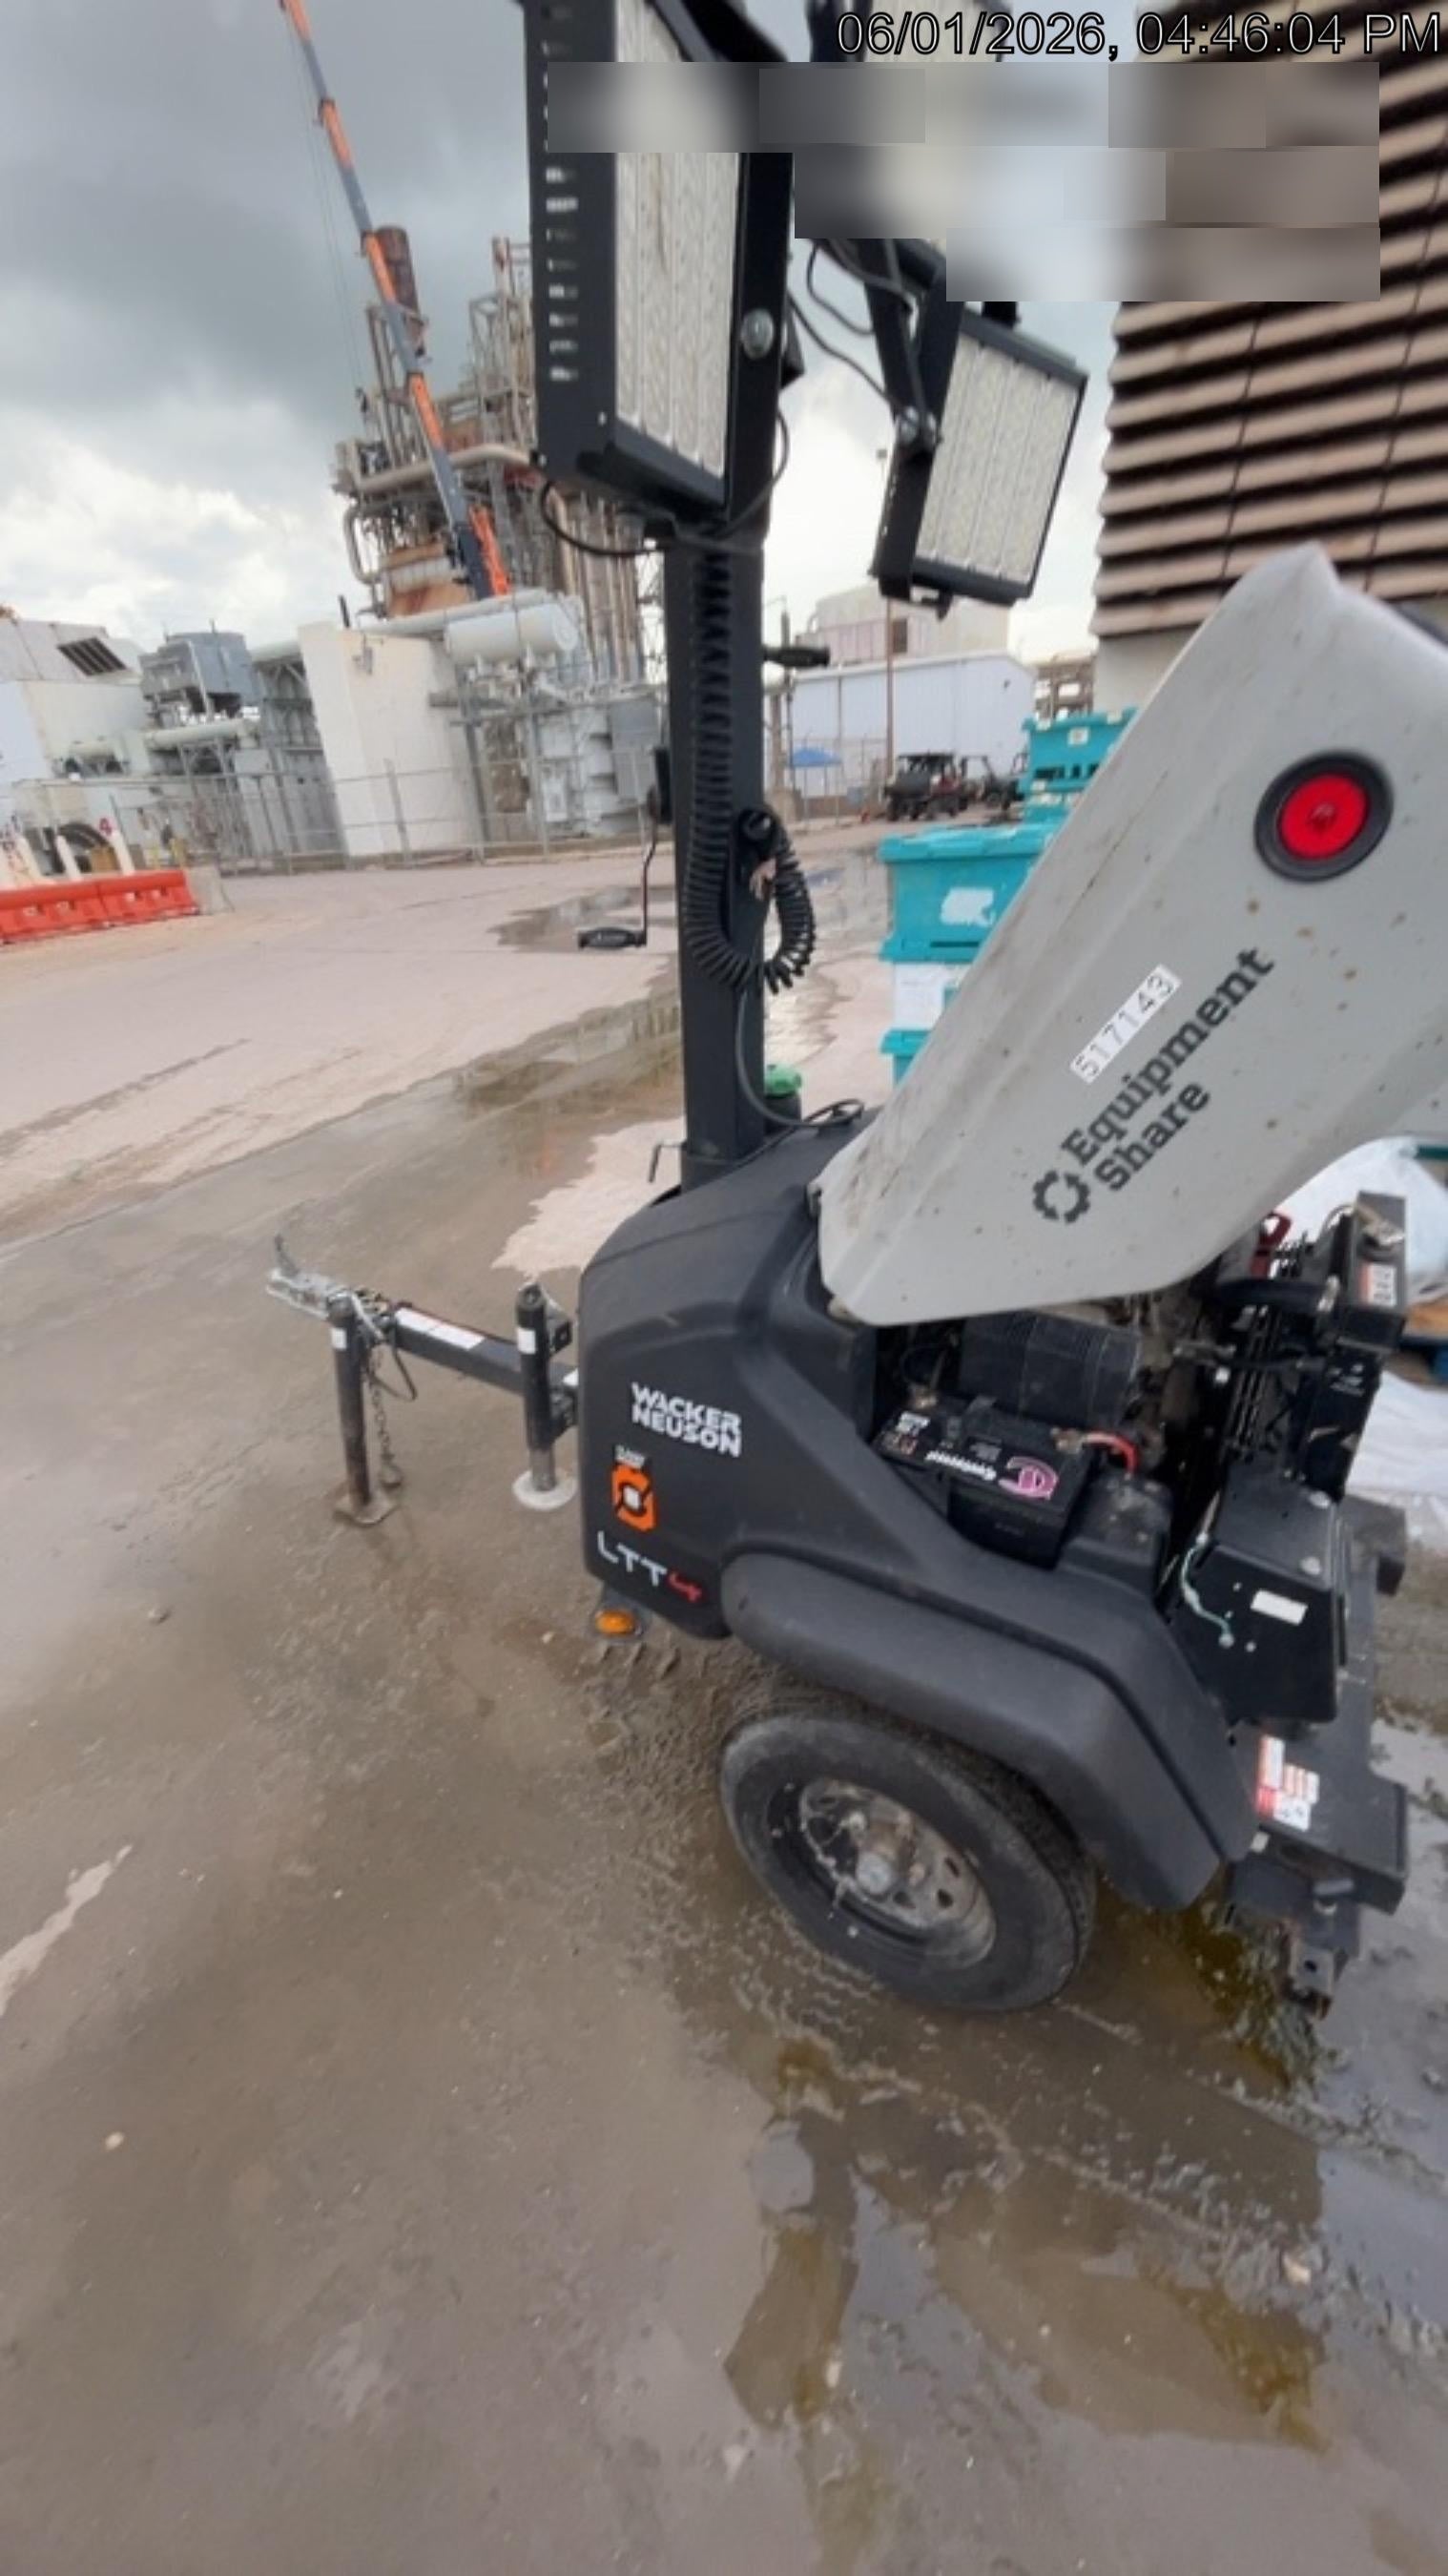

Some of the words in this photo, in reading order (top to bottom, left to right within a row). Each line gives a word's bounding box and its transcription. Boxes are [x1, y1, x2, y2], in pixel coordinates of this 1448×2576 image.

[1061, 948, 1274, 1166] Equipment
[1073, 973, 1174, 1080] 517143
[1093, 1083, 1210, 1191] Share
[631, 1382, 742, 1435] WACKER
[632, 1404, 742, 1457] NEUSON
